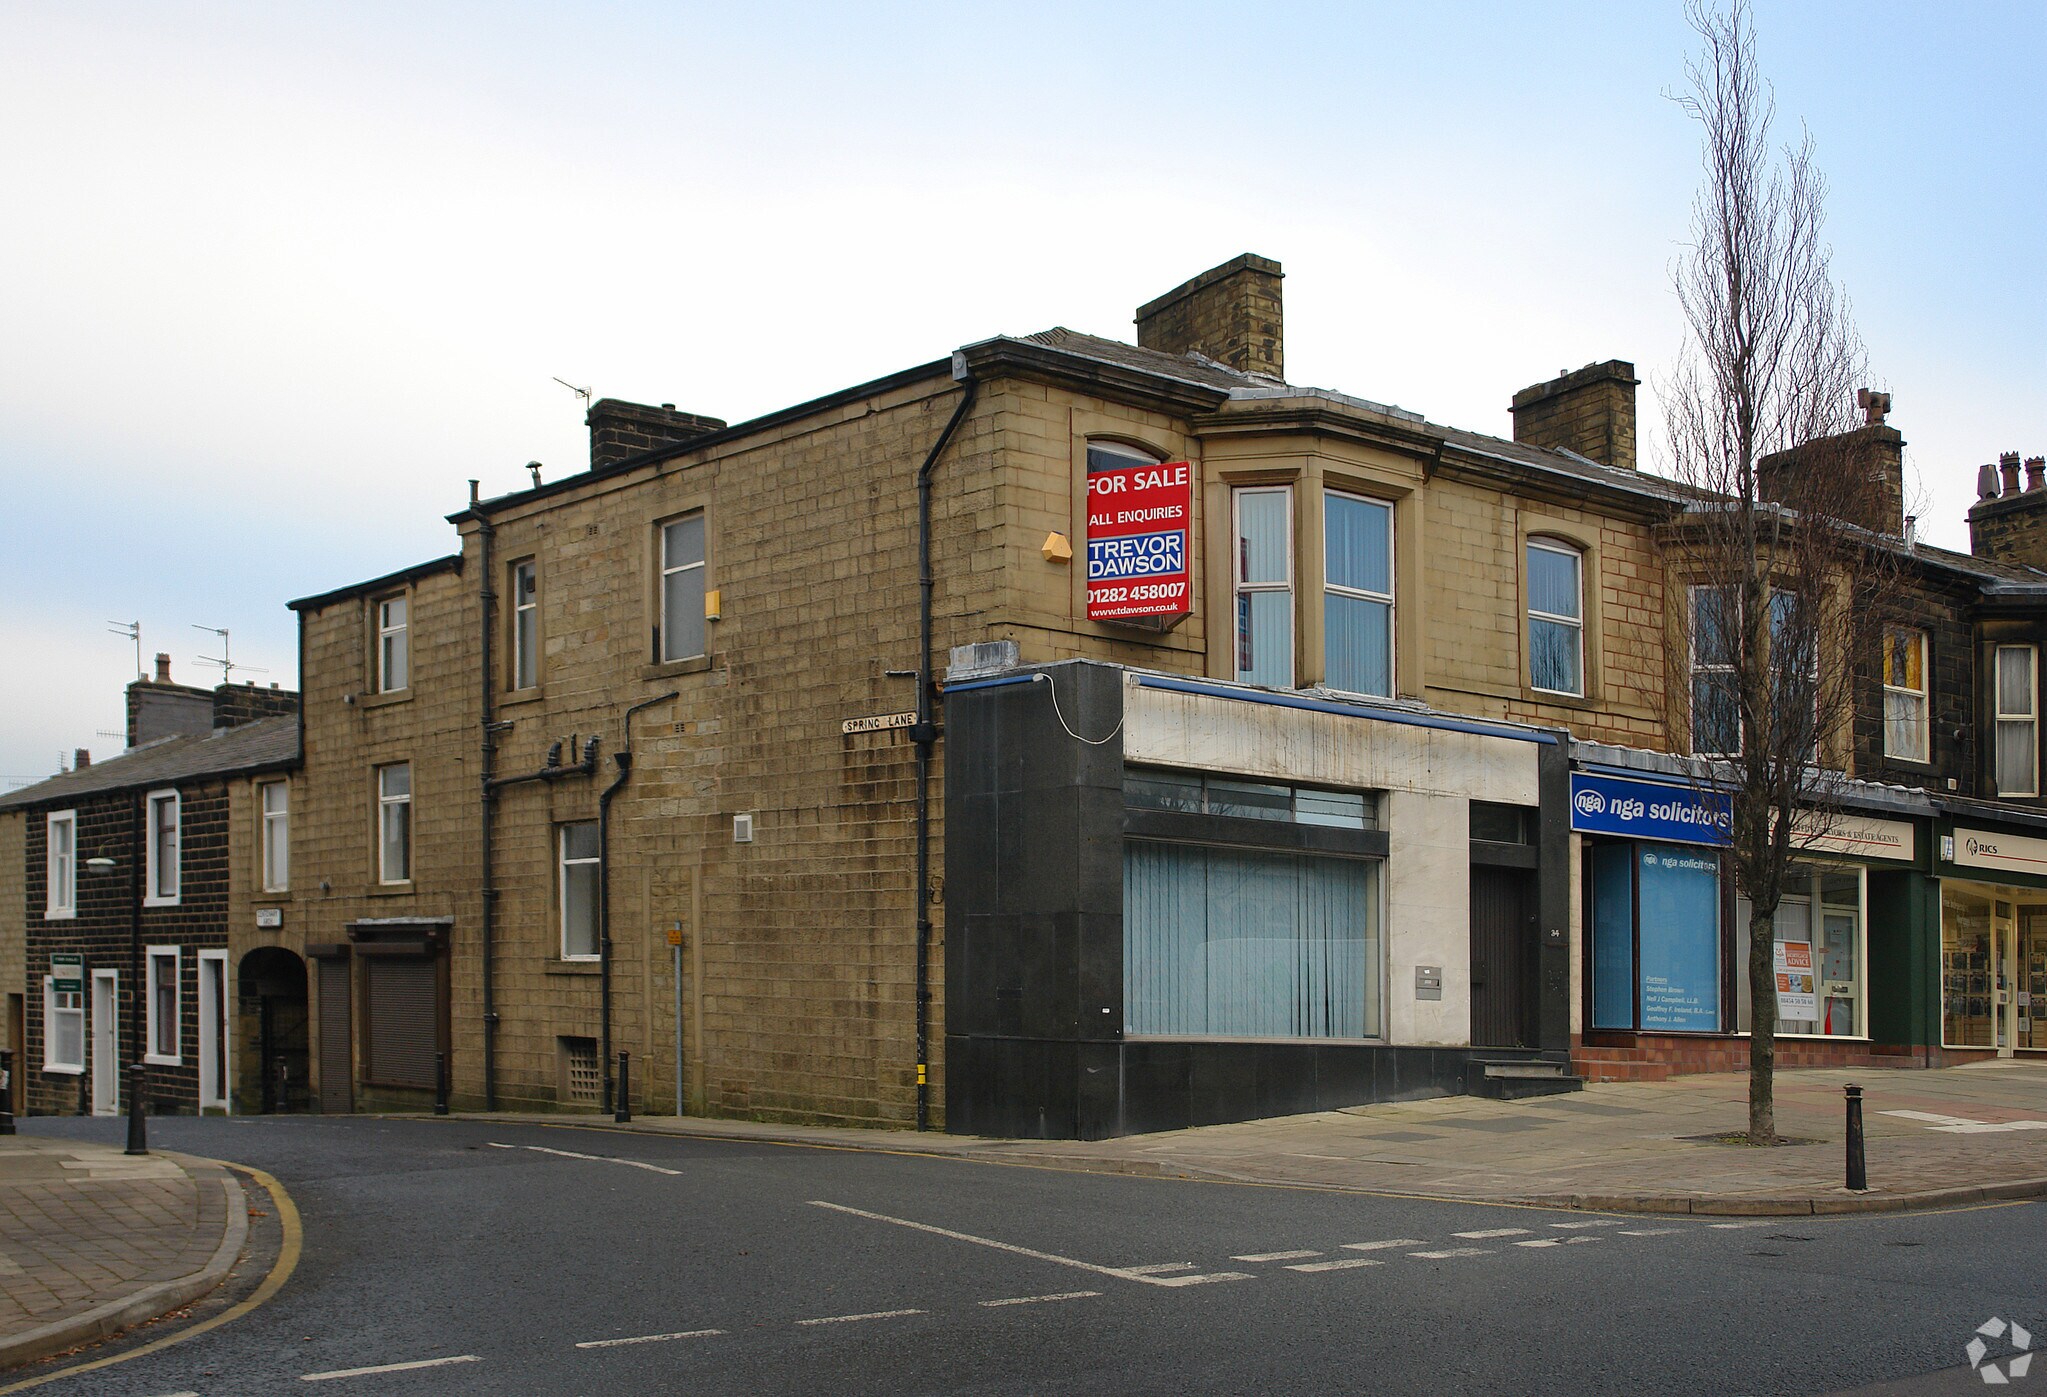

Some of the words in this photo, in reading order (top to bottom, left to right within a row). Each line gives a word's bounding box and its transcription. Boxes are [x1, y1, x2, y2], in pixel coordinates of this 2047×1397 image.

[1087, 475, 1127, 496] FOR
[1134, 467, 1187, 490] SALE
[1089, 513, 1113, 526] ALL
[1118, 505, 1182, 523] ENQUIRIES
[1089, 534, 1180, 559] TREVOR
[1089, 552, 1181, 577] DAWSON
[1087, 587, 1127, 604] 01282
[1129, 582, 1185, 600] 458007
[1091, 602, 1178, 617] www.tdawson.co.uk
[847, 718, 880, 731] SPRING
[888, 714, 913, 726] LANE
[1578, 794, 1602, 813] nga
[1610, 798, 1645, 820] nga
[1648, 801, 1730, 827] solicitors
[1875, 834, 1899, 843] AGENTS
[1979, 843, 1998, 853] RICS
[1662, 857, 1678, 868] nga
[1787, 958, 1809, 967] ADVICE
